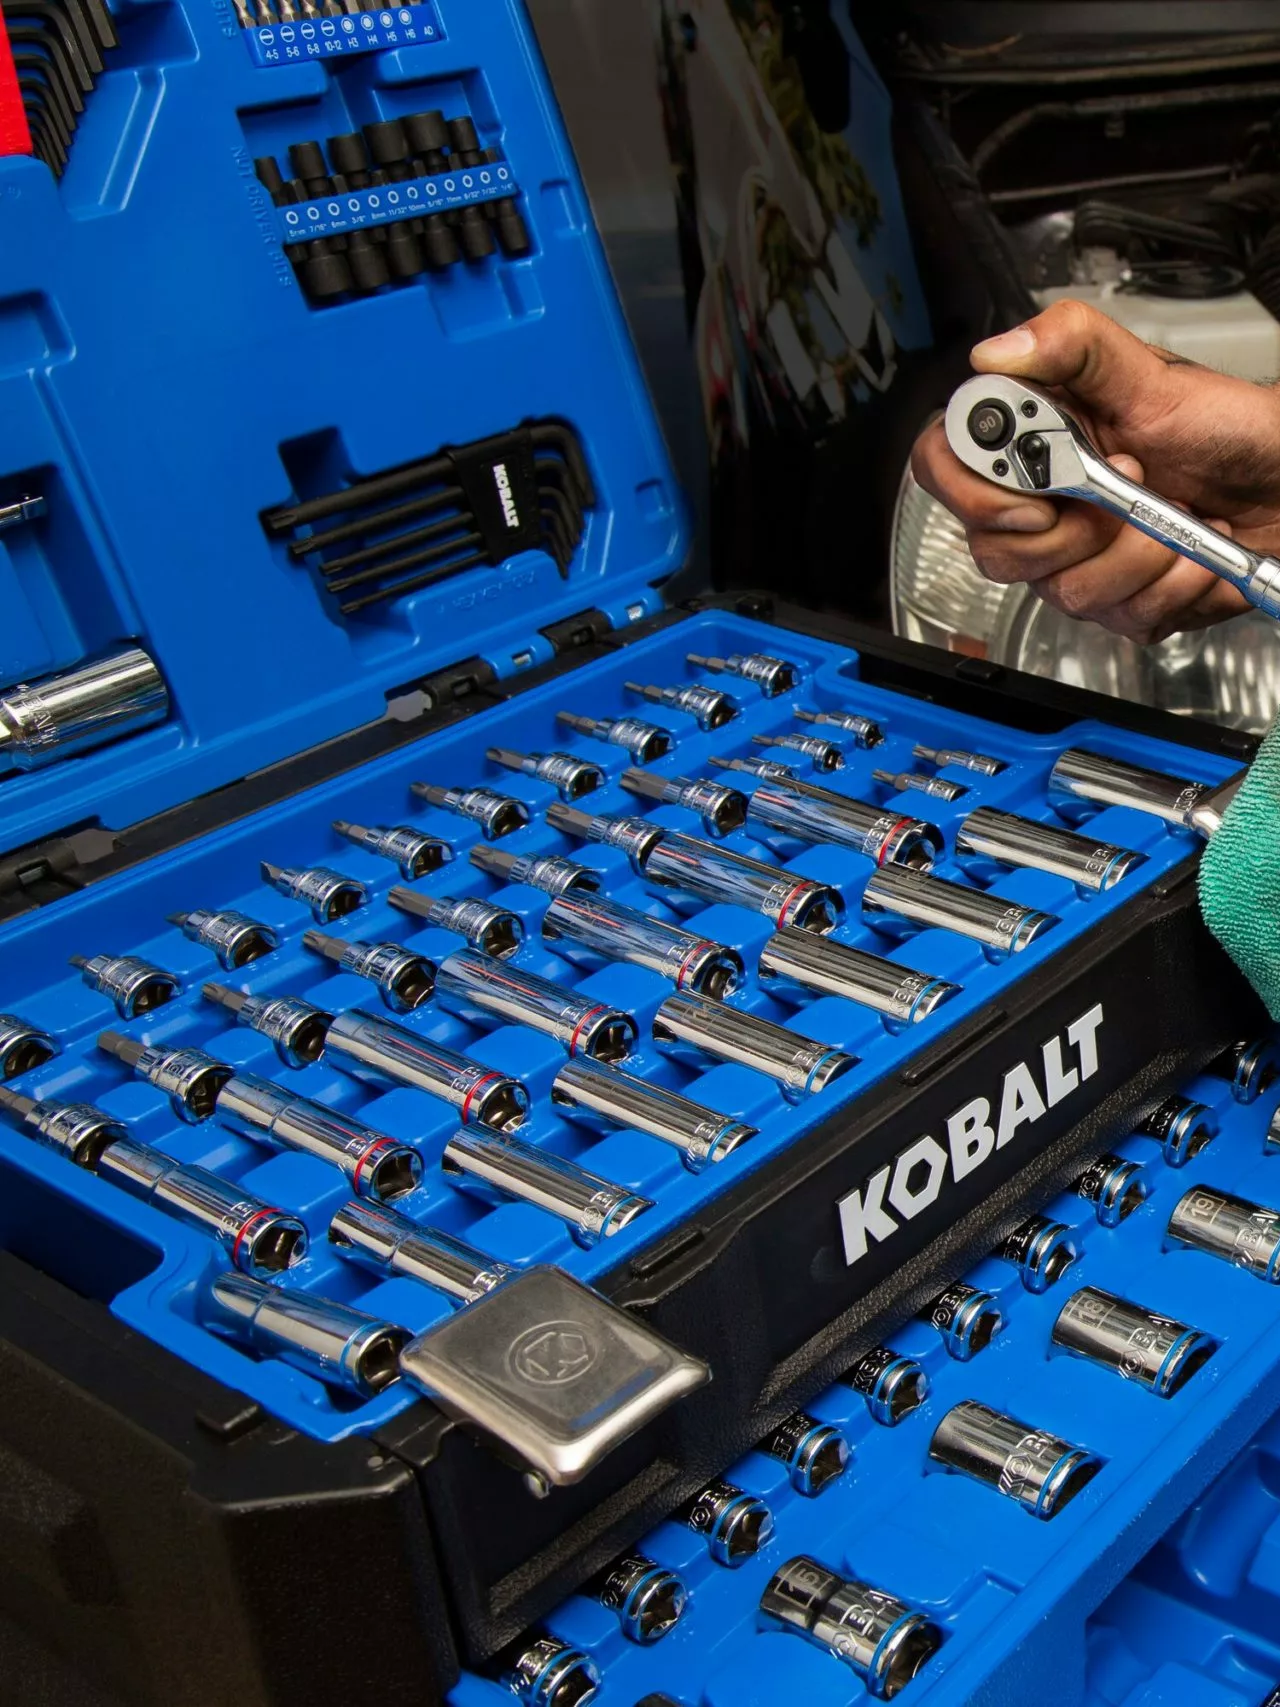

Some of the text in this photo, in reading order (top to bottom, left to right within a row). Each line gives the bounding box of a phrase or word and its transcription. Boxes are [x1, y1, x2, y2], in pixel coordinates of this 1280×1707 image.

[266, 49, 279, 60] 4-5
[286, 46, 300, 57] 5-6
[307, 43, 320, 54] 6-8
[325, 38, 342, 51] 10-12
[348, 36, 359, 48] H3
[367, 34, 378, 46] H4
[979, 416, 996, 432] 90
[493, 464, 519, 527] KOBALT
[1129, 500, 1203, 552] KOBALT
[835, 1003, 1104, 1267] KOBALT
[1191, 1197, 1215, 1217] 19
[1077, 1299, 1105, 1326] 18
[789, 1568, 820, 1596] 15
